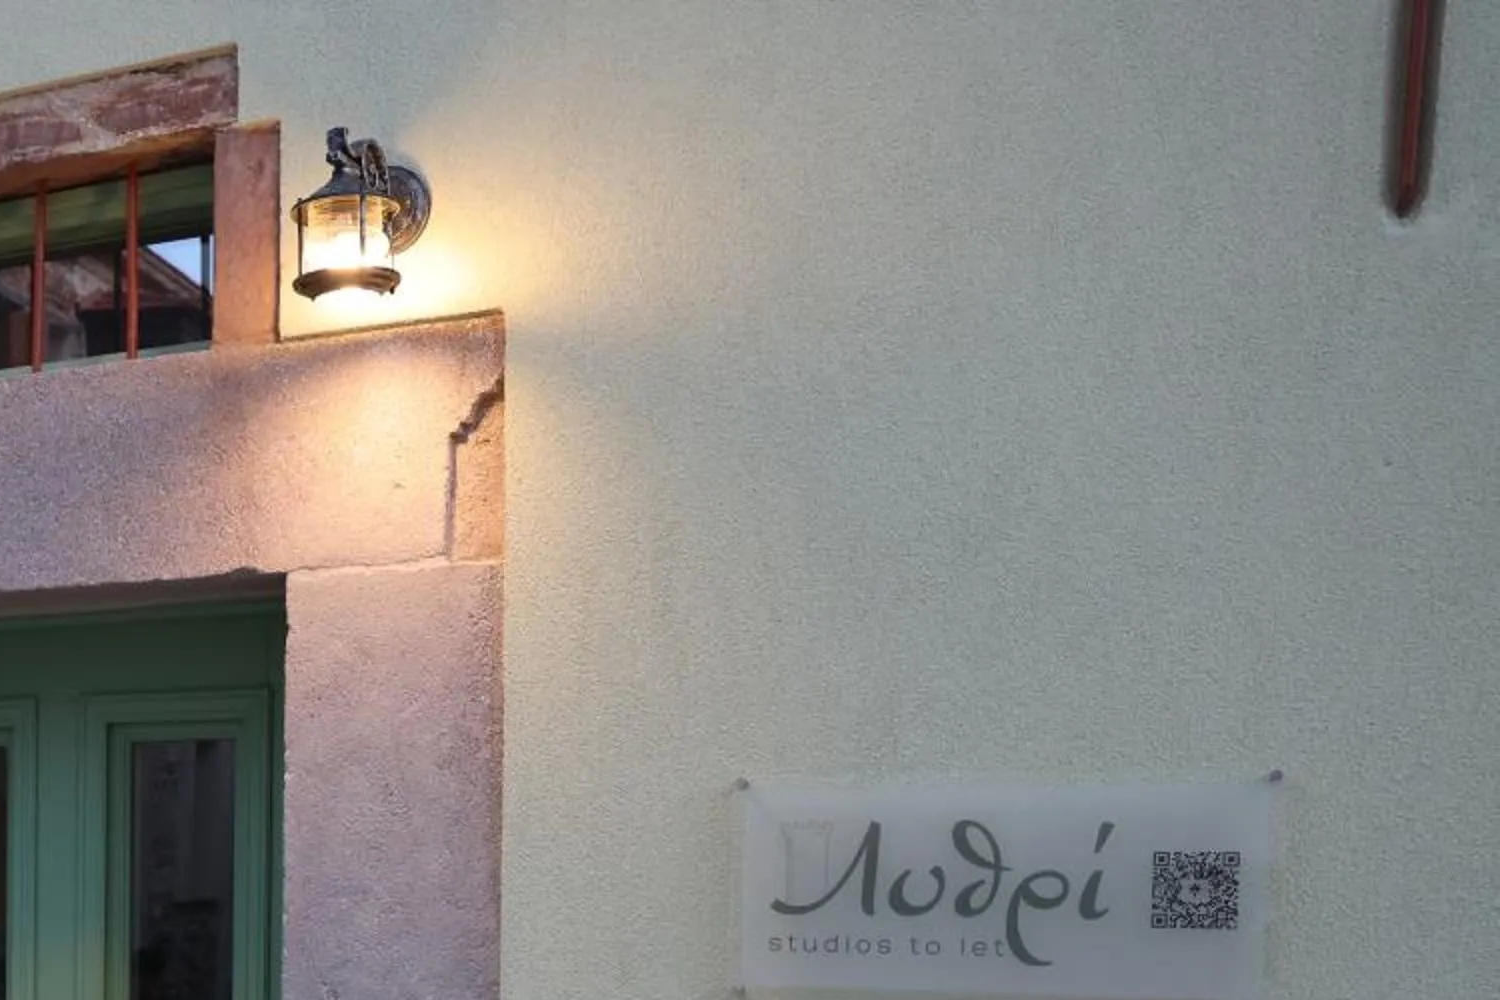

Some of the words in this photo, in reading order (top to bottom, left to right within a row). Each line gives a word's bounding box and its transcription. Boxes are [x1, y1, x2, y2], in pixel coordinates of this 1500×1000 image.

[769, 935, 892, 956] studios
[910, 937, 942, 957] to
[961, 937, 1005, 958] let
